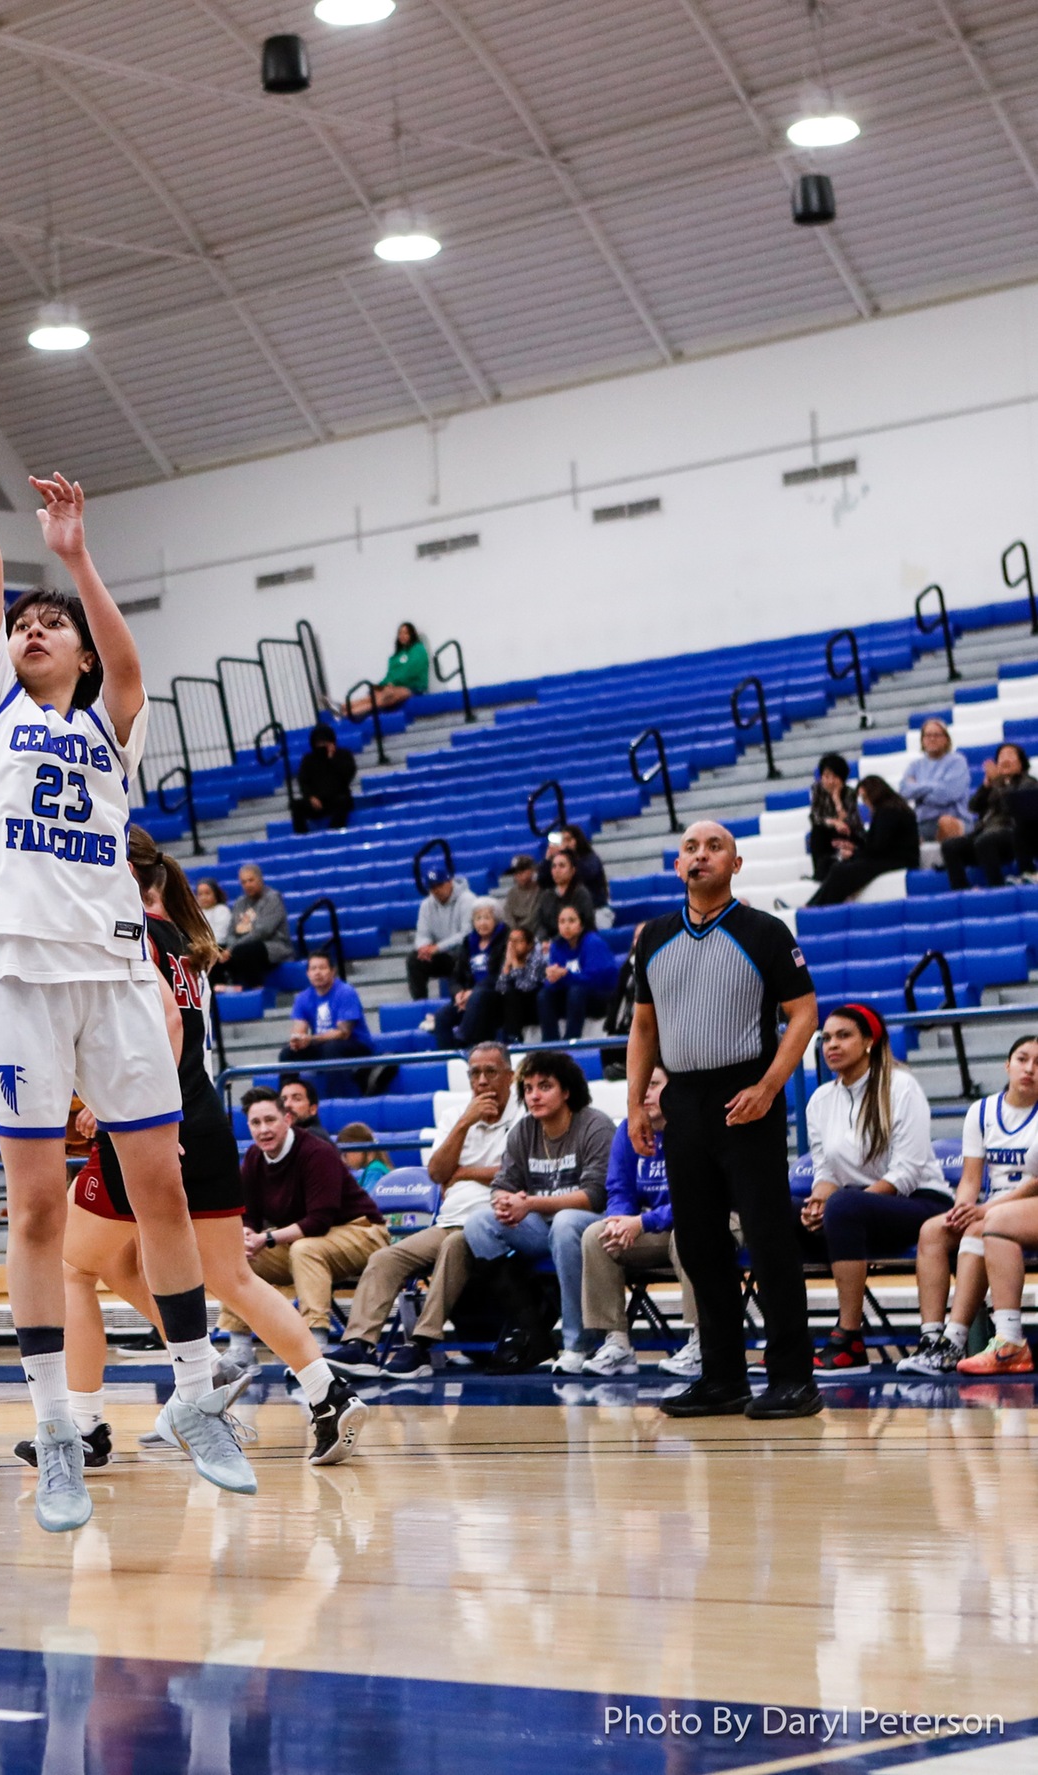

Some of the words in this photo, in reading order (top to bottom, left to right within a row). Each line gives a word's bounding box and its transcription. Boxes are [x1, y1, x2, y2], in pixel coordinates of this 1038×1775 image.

[31, 763, 94, 824] 23
[5, 817, 117, 867] FALCONS
[166, 951, 203, 1010] 20
[84, 1176, 99, 1202] C
[376, 1185, 405, 1195] Cerritos
